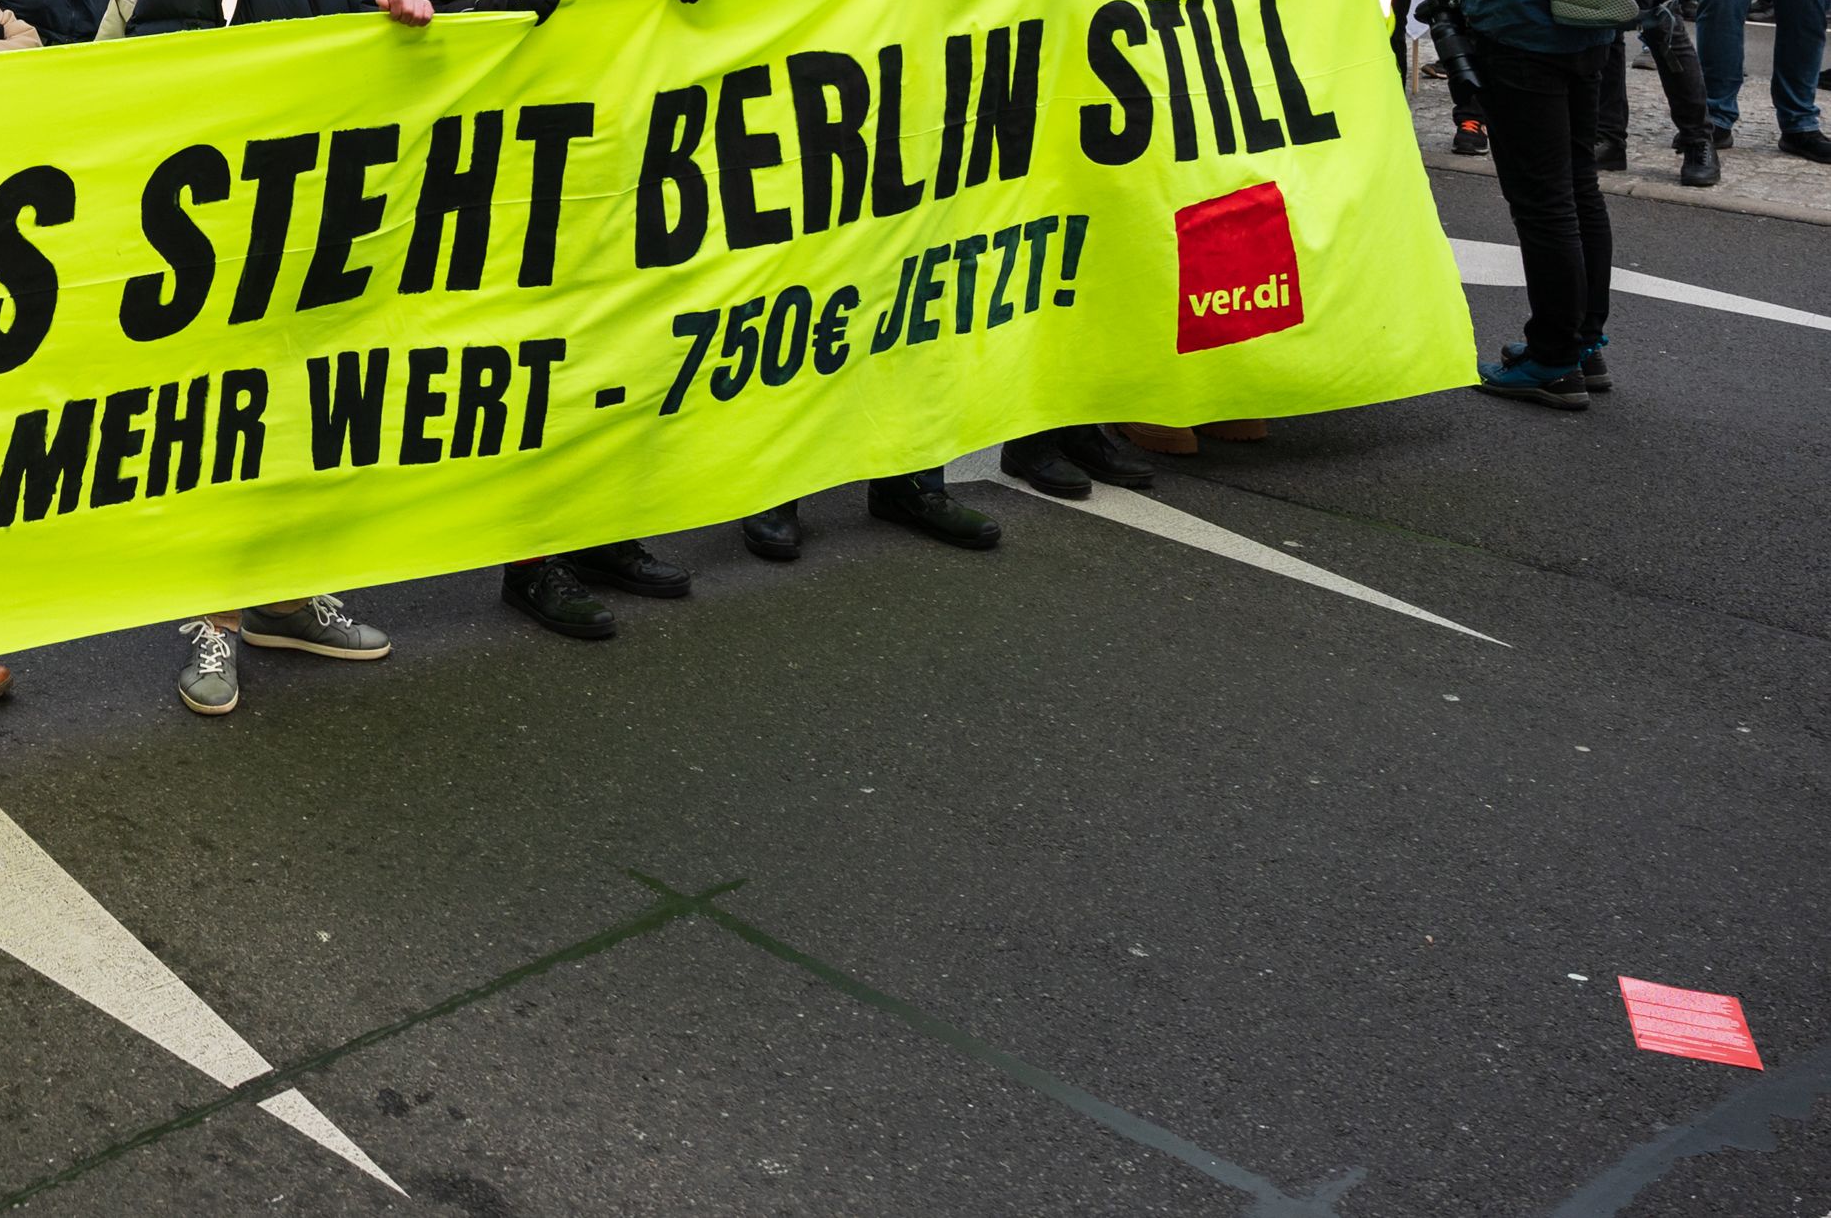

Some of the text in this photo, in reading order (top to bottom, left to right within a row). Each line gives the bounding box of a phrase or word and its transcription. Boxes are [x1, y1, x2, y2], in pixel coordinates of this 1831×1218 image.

[119, 102, 594, 341] STEHT
[635, 19, 1043, 269] BERLIN
[1188, 272, 1290, 318] ver.di
[307, 338, 566, 470] WERT
[595, 386, 625, 408] -
[659, 285, 861, 416] 750€
[870, 215, 1089, 354] JETZT!
